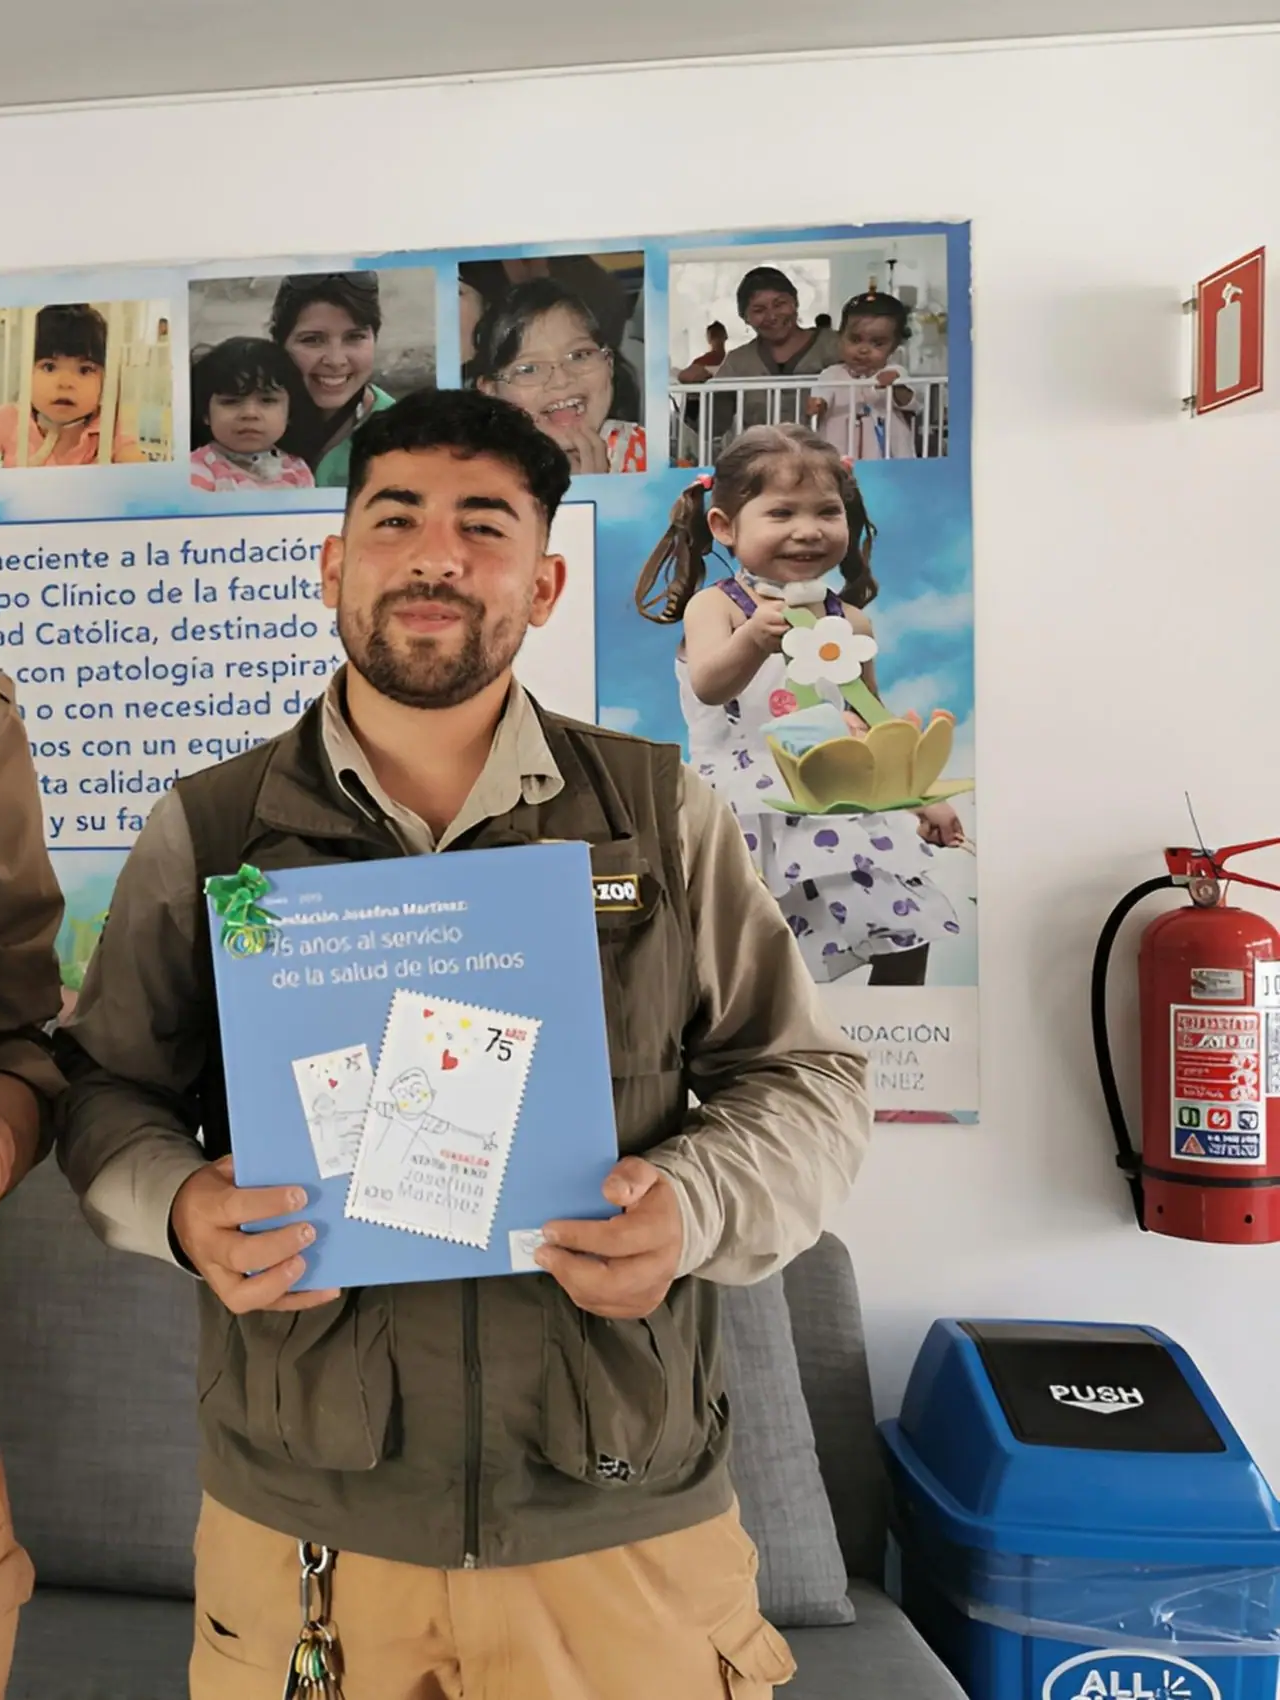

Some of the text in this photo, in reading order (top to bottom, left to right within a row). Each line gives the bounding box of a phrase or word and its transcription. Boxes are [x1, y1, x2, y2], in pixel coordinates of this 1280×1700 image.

[121, 551, 135, 567] a
[147, 542, 169, 566] la
[40, 582, 136, 607] Clínico
[147, 579, 183, 604] de
[195, 578, 218, 604] la
[35, 619, 158, 647] Católica,
[171, 613, 318, 641] destinado
[16, 666, 65, 683] con
[77, 655, 214, 688] patología
[36, 704, 53, 720] o
[64, 702, 114, 719] con
[125, 691, 271, 719] necesidad
[82, 740, 131, 757] con
[143, 739, 176, 756] un
[49, 815, 64, 839] y
[76, 814, 106, 831] su
[299, 934, 352, 957] años
[357, 929, 376, 951] al
[381, 924, 463, 949] servicio
[272, 951, 525, 990] de la salud de los niños
[1049, 1384, 1144, 1405] PUSH
[1080, 1668, 1154, 1698] ALL
